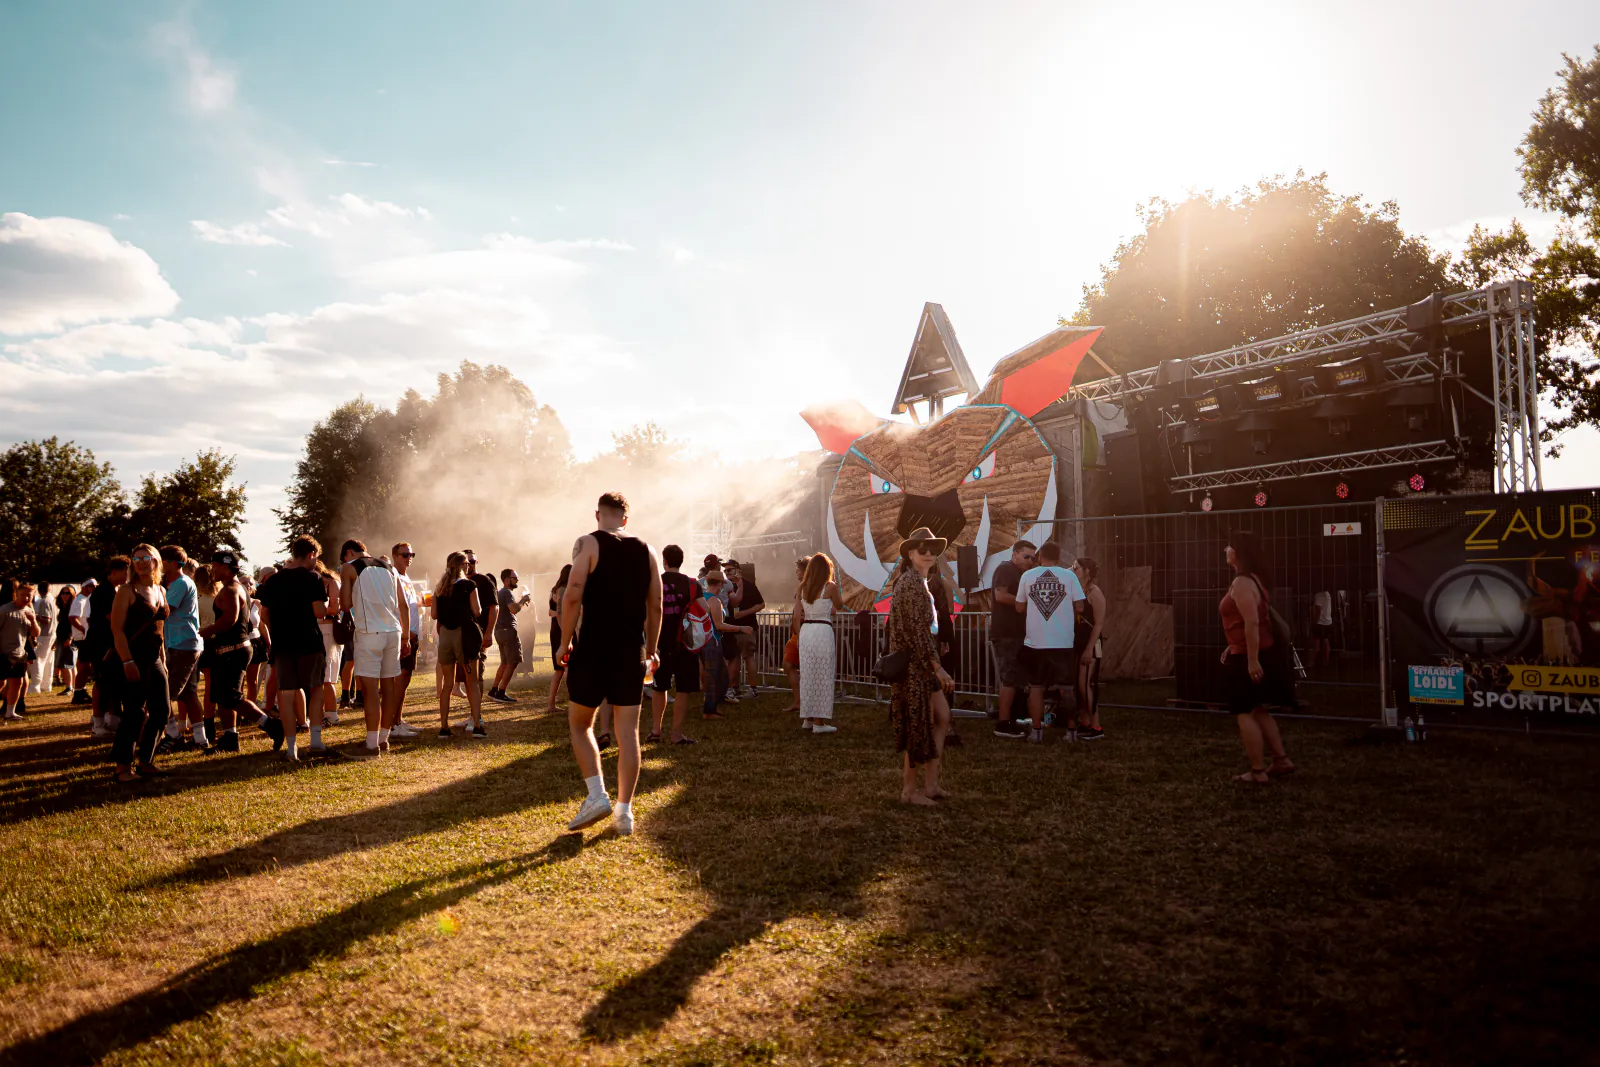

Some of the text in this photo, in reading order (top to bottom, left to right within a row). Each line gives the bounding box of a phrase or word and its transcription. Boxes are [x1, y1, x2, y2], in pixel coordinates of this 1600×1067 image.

[1465, 505, 1597, 549] ZAUB
[1414, 676, 1457, 690] LOIDL
[1549, 674, 1600, 688] ZAUB
